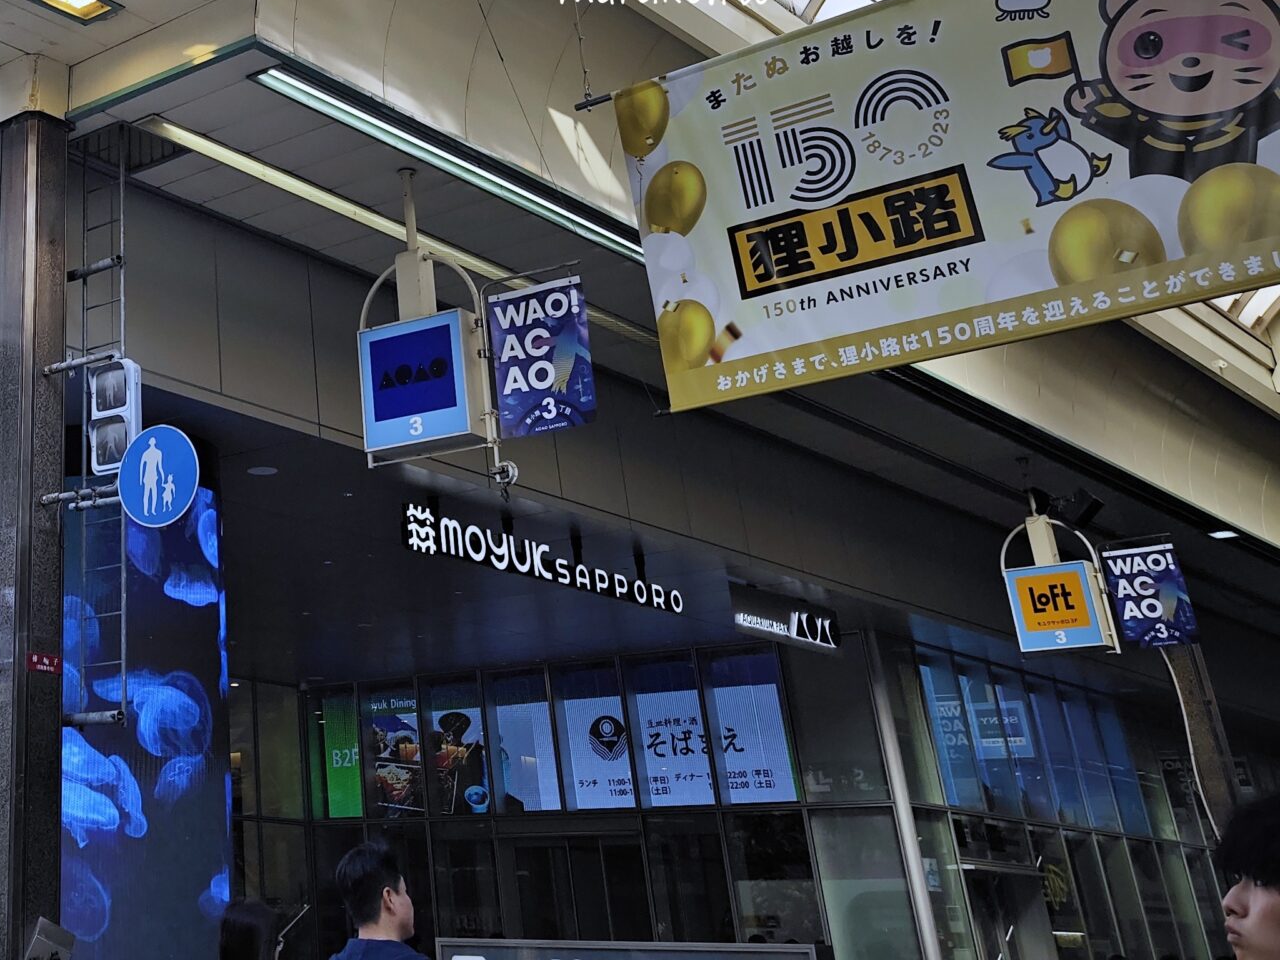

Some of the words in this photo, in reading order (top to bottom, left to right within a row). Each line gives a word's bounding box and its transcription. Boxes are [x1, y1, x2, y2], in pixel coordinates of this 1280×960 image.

[721, 69, 951, 211] 150
[861, 107, 951, 166] 1873-2023
[746, 183, 962, 284] 狸小路
[762, 296, 818, 320] 150th
[825, 257, 972, 306] ANNIVERSARY
[493, 290, 581, 331] WAO!
[500, 327, 551, 363] AC
[502, 359, 556, 395] AO
[408, 416, 424, 436] 3
[1106, 552, 1176, 576] WAO!
[555, 558, 684, 614] SAPPORO
[1117, 575, 1156, 598] AC
[1123, 599, 1164, 620] AO
[1055, 630, 1068, 644] 3
[390, 698, 417, 709] Dining
[577, 779, 599, 788] ランチ
[674, 773, 704, 782] ディナー
